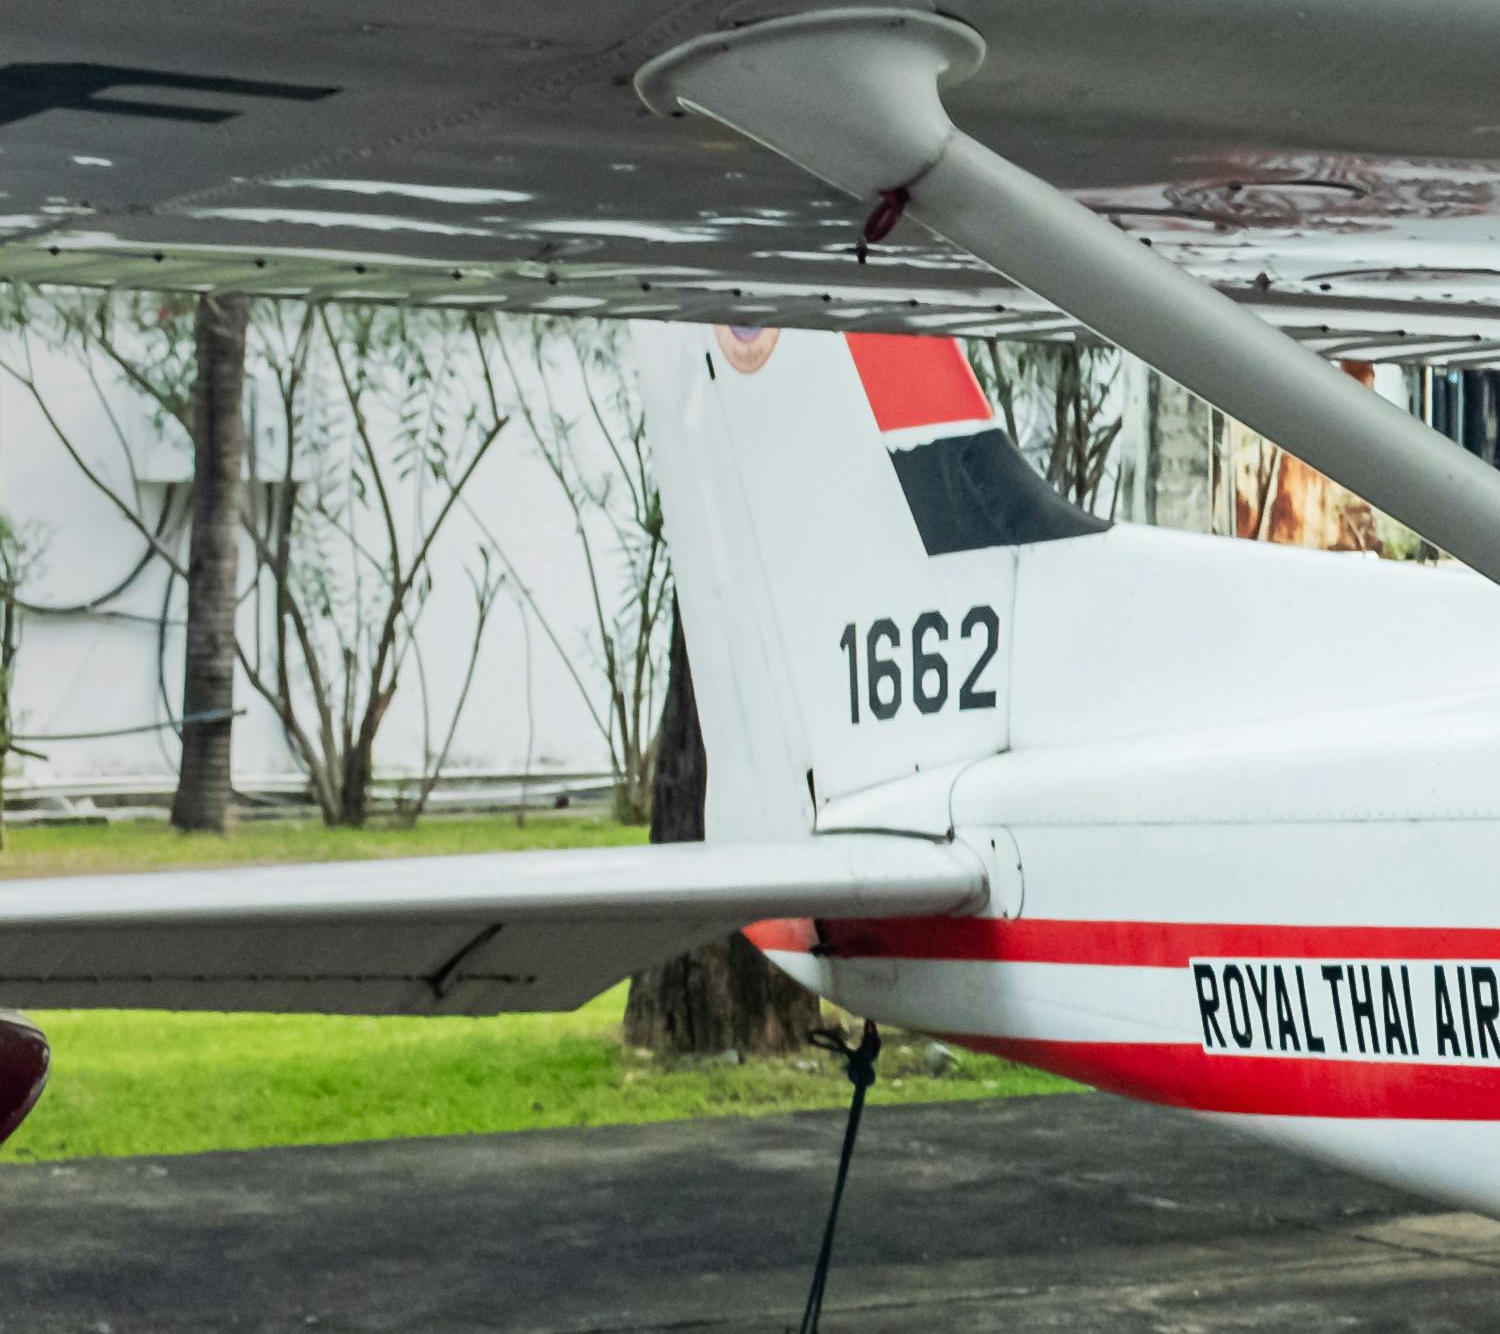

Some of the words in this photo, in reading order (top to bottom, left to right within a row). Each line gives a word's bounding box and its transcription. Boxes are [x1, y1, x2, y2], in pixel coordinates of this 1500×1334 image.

[839, 604, 1000, 725] 1662
[1194, 964, 1326, 1053] ROYAL
[1321, 964, 1420, 1056] THAI
